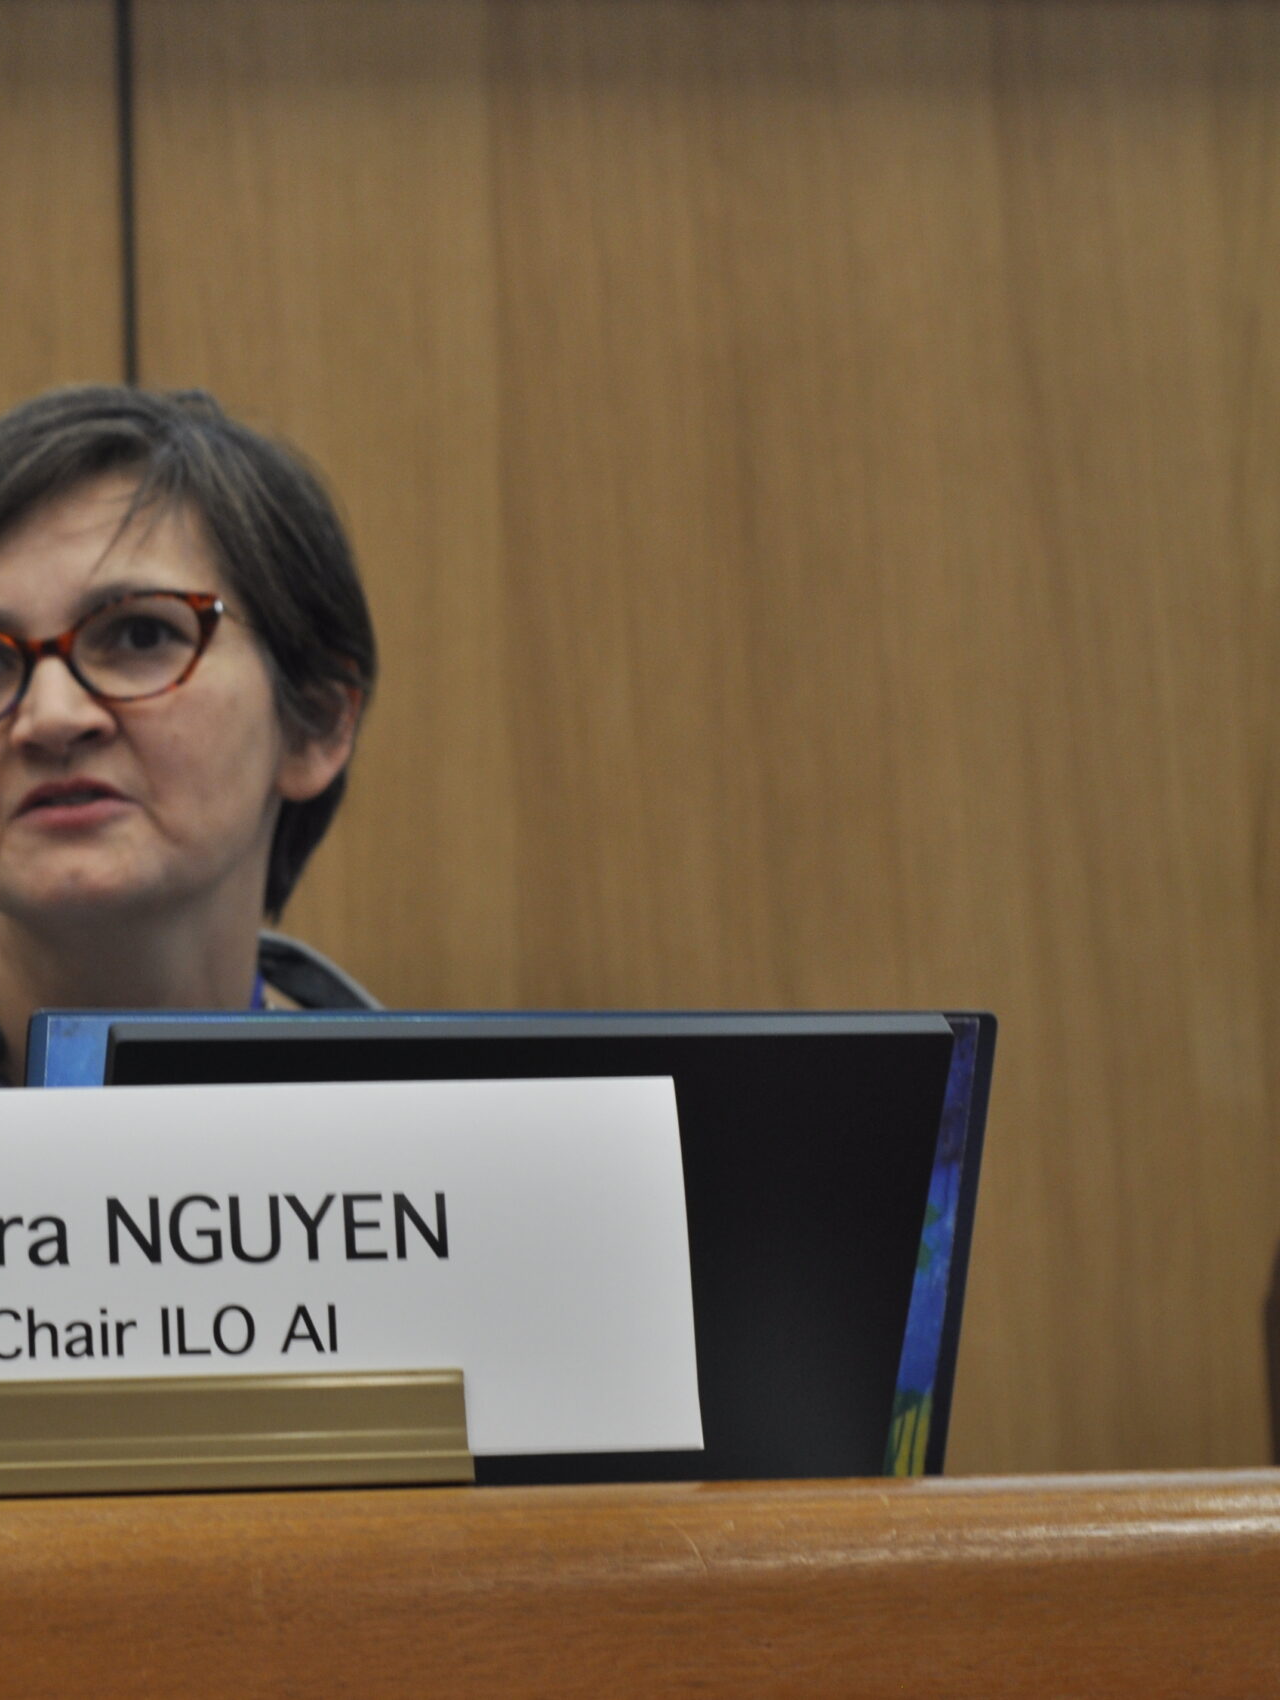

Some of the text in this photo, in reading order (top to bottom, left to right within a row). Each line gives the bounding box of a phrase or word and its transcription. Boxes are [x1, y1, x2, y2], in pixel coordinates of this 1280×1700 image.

[106, 1192, 450, 1266] NGUYEN
[160, 1304, 257, 1357] ILO
[281, 1303, 339, 1354] AI
